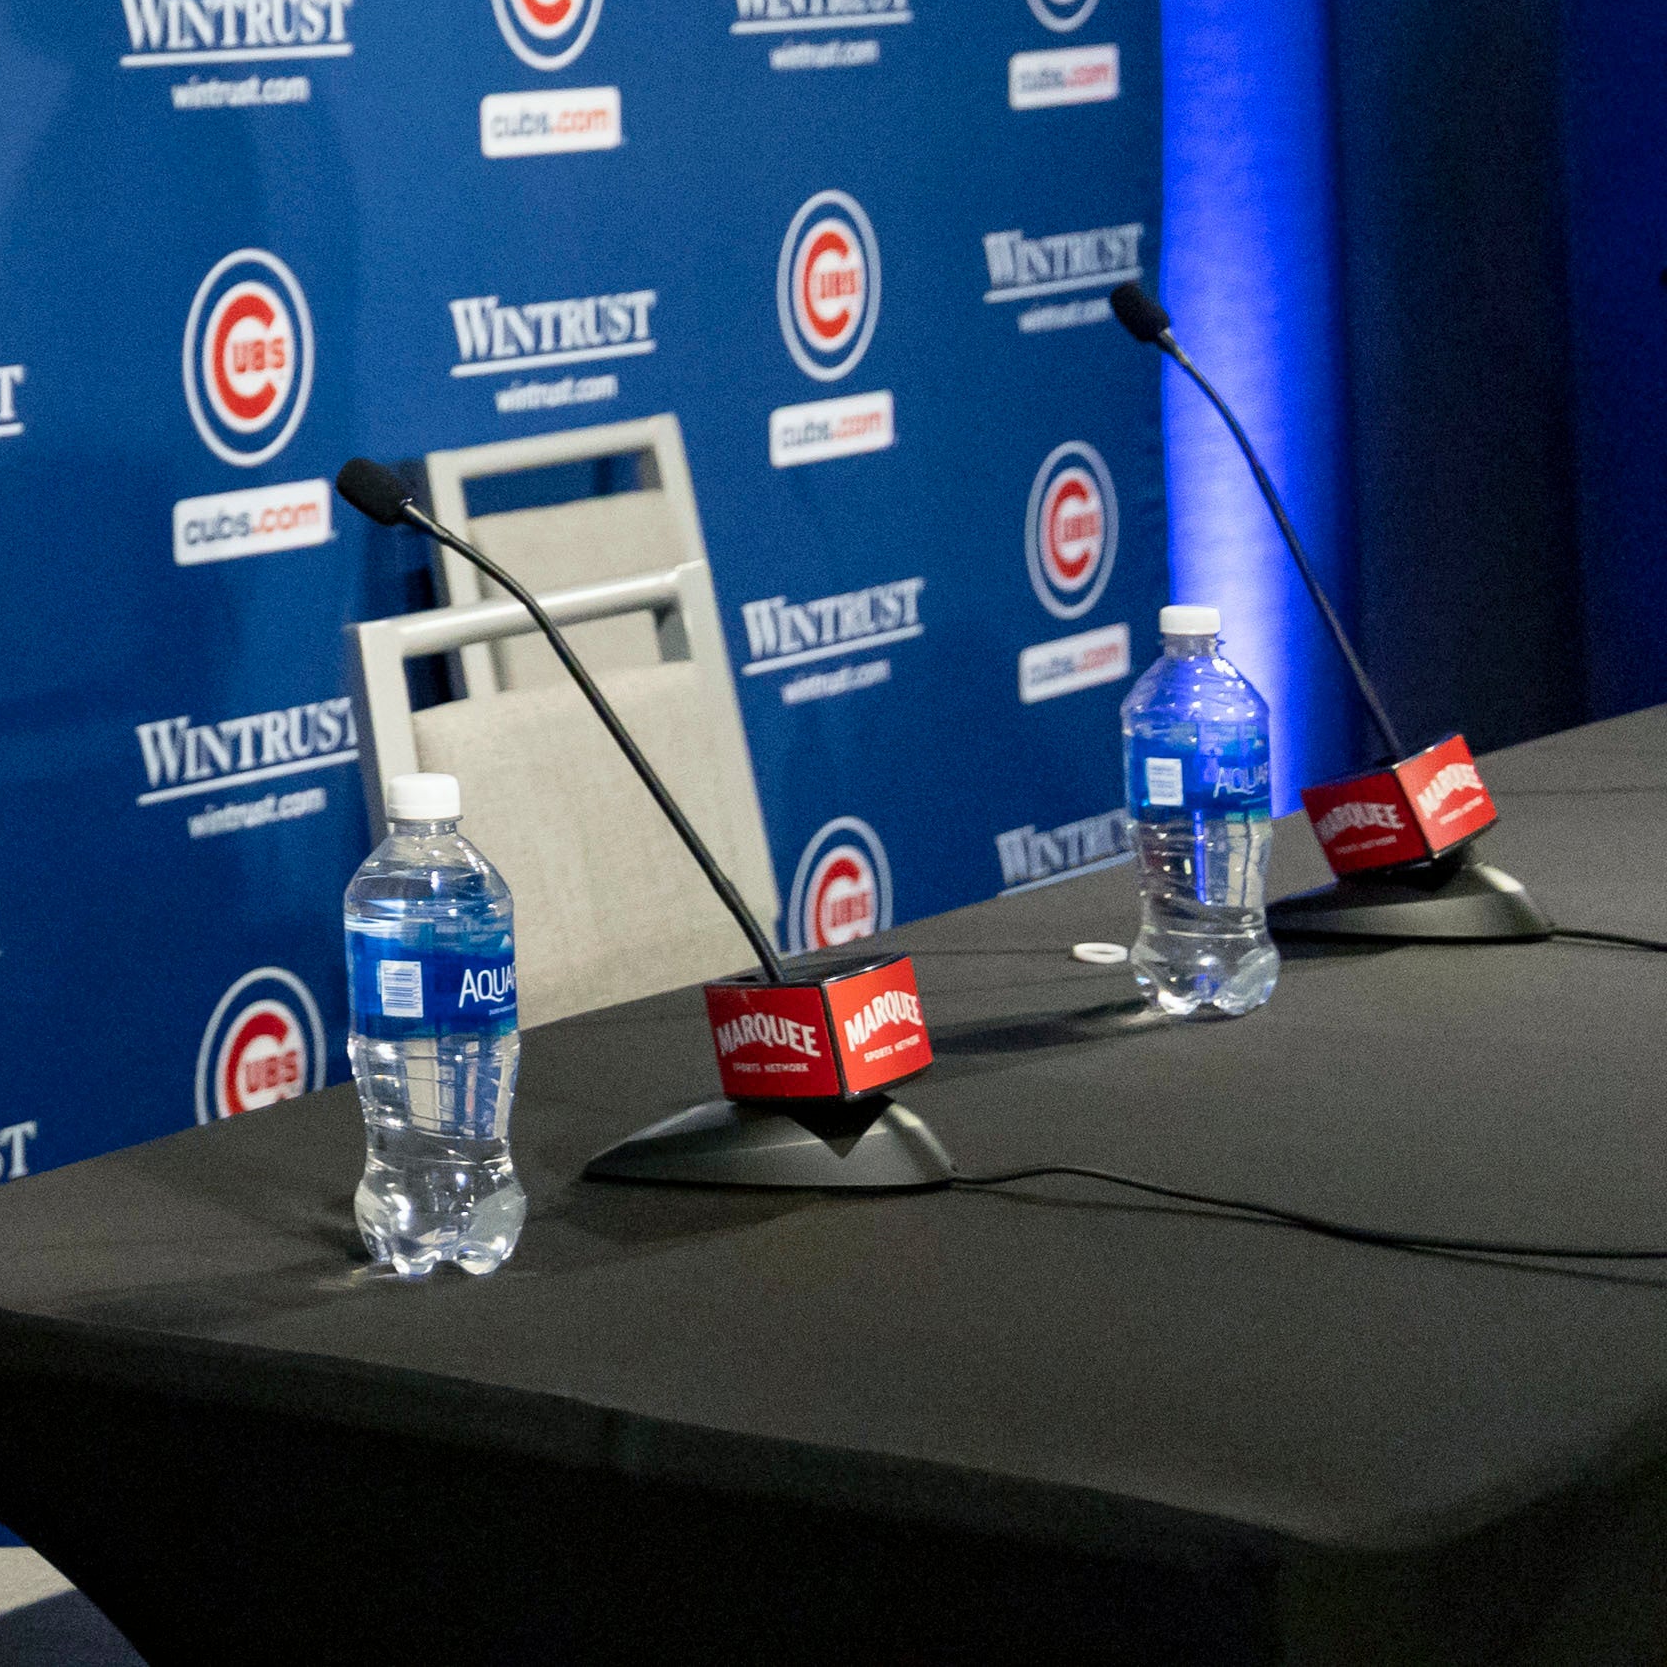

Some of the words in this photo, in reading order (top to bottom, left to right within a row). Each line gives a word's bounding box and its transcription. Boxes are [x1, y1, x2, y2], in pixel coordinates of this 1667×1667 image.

[172, 76, 310, 109] wintrust.com
[490, 105, 613, 139] cubs.com
[449, 290, 656, 360] WINTRUST
[213, 293, 285, 421] CUBS
[183, 500, 320, 546] cubs.com
[742, 577, 925, 659] WINTRUST
[1213, 762, 1269, 798] AQUA
[458, 962, 516, 1008] AQUA
[717, 1013, 821, 1057] MARQUEE
[844, 990, 923, 1053] MARQUEE
